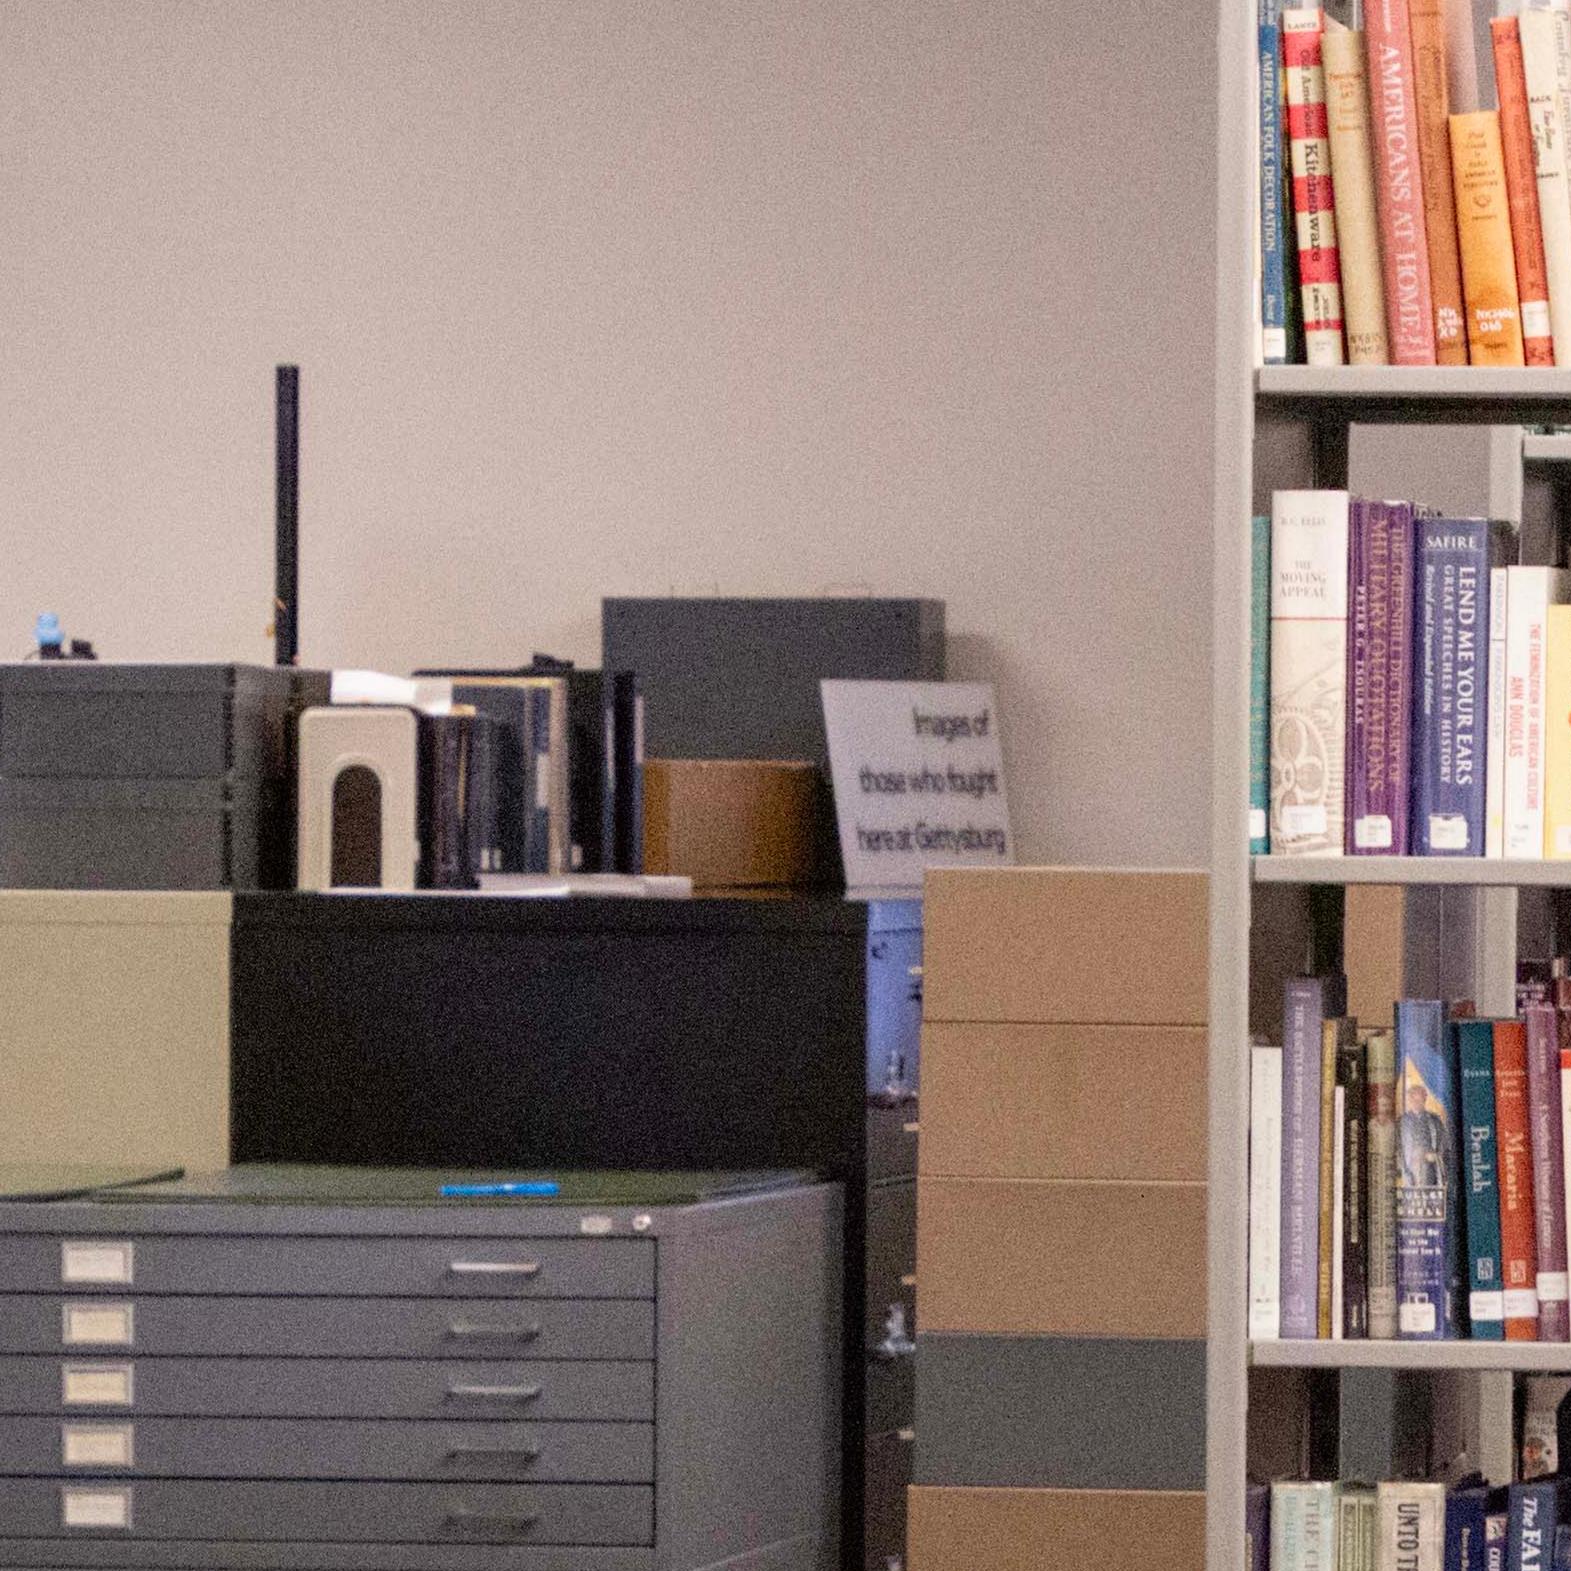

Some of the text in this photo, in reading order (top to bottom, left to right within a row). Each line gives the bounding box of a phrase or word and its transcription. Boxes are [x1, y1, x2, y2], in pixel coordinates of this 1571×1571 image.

[1264, 51, 1276, 252] AMERICAN FOLK DECORATION
[1379, 44, 1420, 332] AMERICANS AT HOME
[1304, 144, 1324, 262] Kitchenware
[1426, 536, 1477, 549] SAFIRE
[1368, 519, 1385, 792] MILITARY QUOTATIONS
[1440, 565, 1453, 783] GREAT SPEECHES IN HISTORY
[1456, 566, 1475, 786] LEND ME YOUR EARS
[1509, 676, 1523, 758] ANN DOUGLAS
[1470, 1125, 1490, 1193] Beulah
[1504, 1131, 1525, 1210] Macaria
[1305, 1500, 1319, 1542] THE
[1397, 1503, 1419, 1551] UNTO
[1523, 1497, 1538, 1526] The
